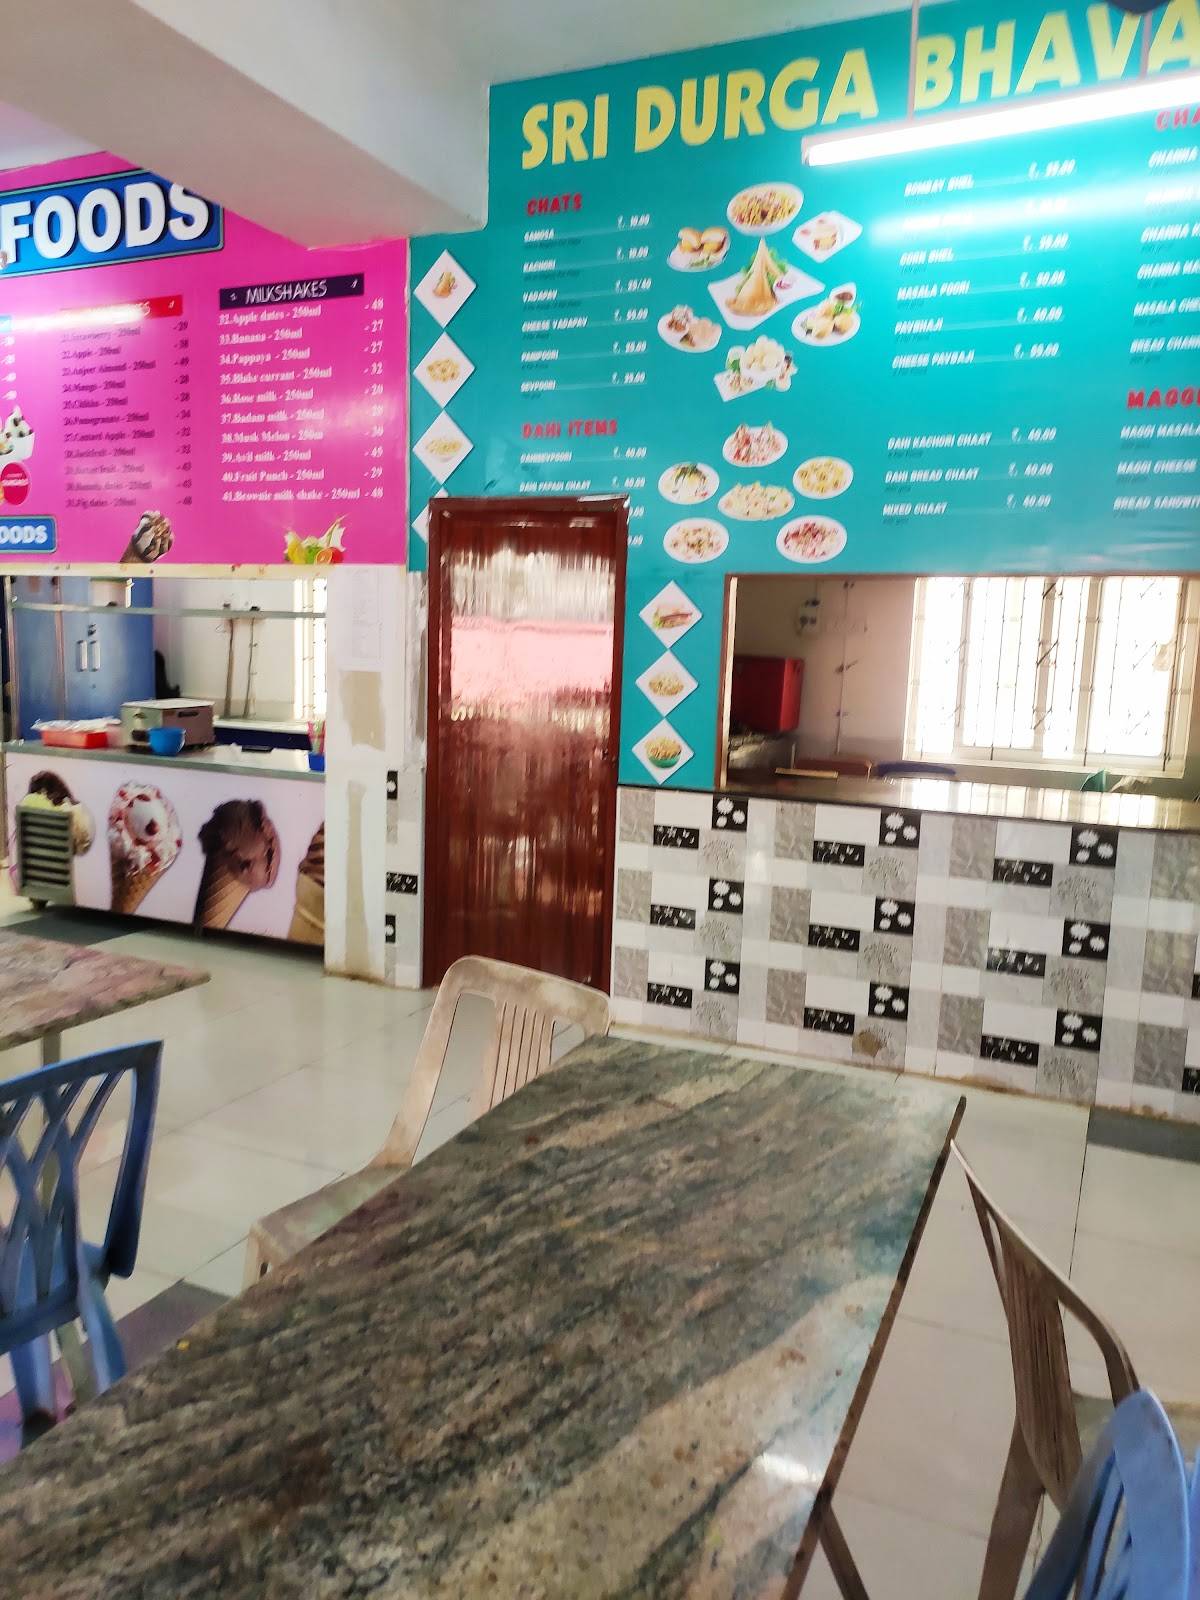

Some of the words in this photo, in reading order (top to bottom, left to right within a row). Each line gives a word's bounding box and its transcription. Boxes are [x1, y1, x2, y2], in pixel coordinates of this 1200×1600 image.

[522, 94, 609, 170] SRI
[635, 48, 880, 153] DURGA
[527, 193, 582, 216] CHATS
[0, 182, 209, 269] FOODS
[246, 280, 327, 304] MILKSHAKES
[523, 423, 560, 438] DAHI
[568, 419, 617, 437] ITEMS
